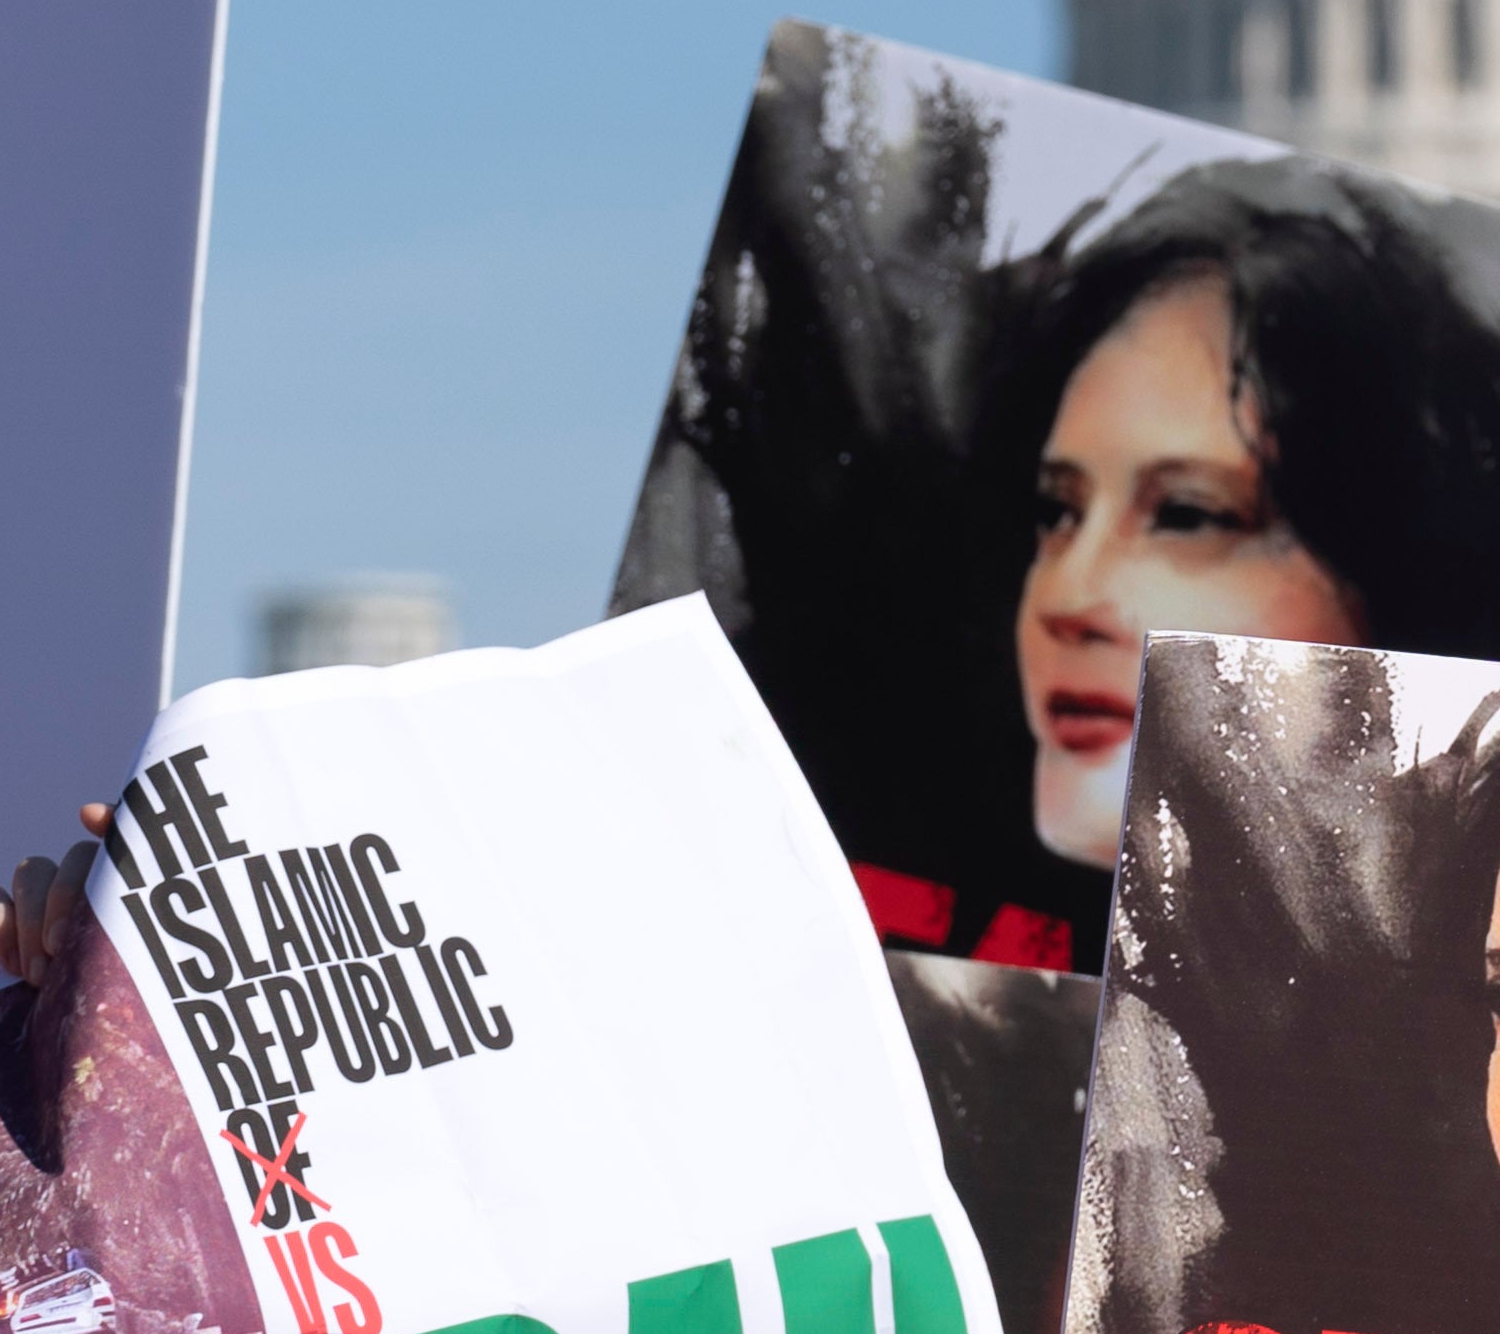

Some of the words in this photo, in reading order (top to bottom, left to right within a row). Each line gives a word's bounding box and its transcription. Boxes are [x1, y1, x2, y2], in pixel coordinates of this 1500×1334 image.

[119, 833, 426, 1000] ISLAMIC
[173, 936, 515, 1112] REPUBLIC
[225, 1099, 318, 1230] OF
